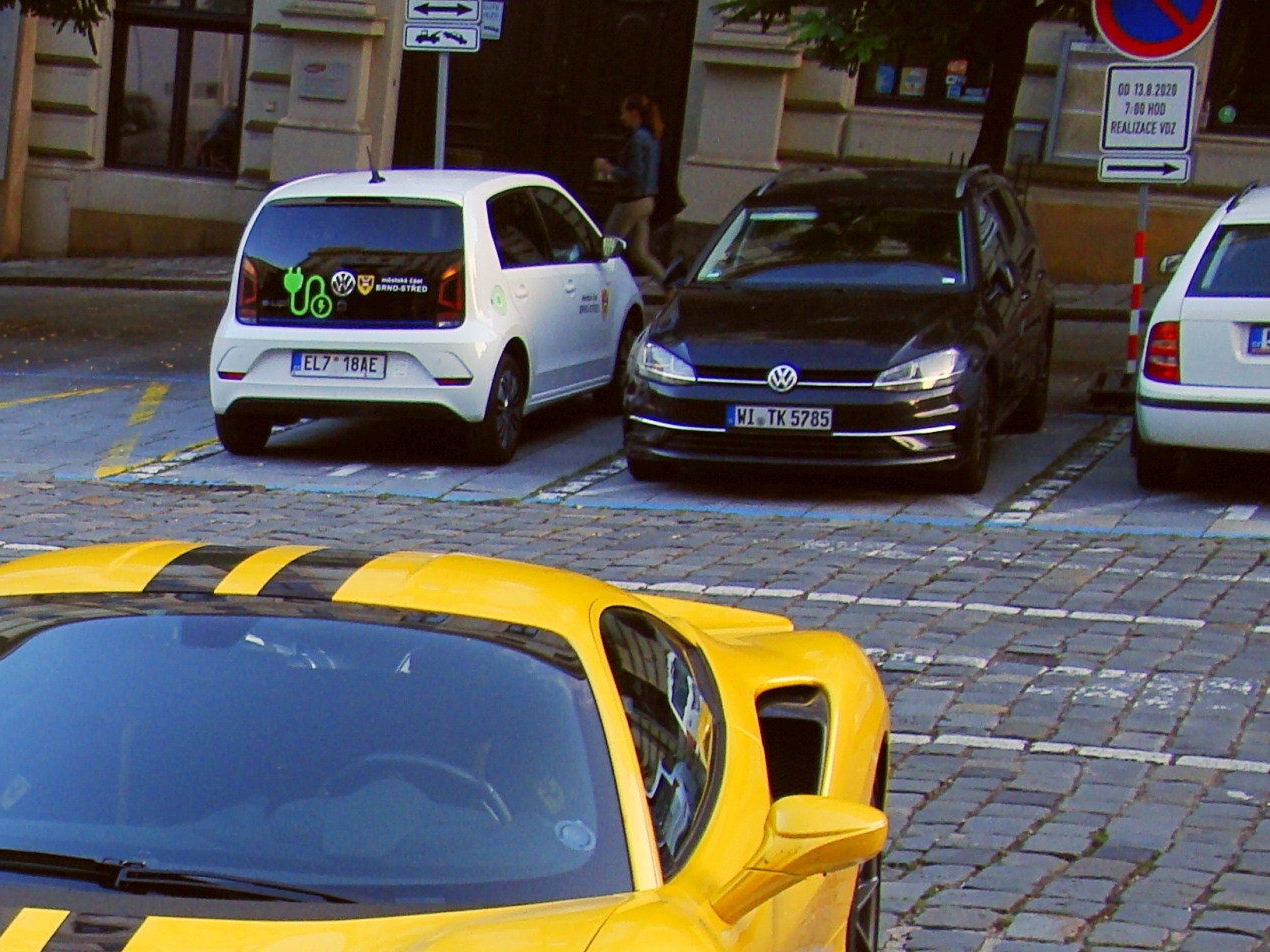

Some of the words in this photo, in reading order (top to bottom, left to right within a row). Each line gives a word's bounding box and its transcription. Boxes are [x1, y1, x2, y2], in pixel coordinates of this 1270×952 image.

[1117, 82, 1130, 96] OD
[1134, 82, 1177, 97] 13.8.2020
[1147, 102, 1166, 116] HOD
[1110, 120, 1157, 135] REALIZACE
[375, 284, 428, 293] BRNO-STŘED
[304, 354, 331, 371] EL7
[343, 356, 378, 373] 18AE
[737, 408, 754, 425] WI
[768, 409, 786, 426] TK
[791, 410, 830, 427] 5785
